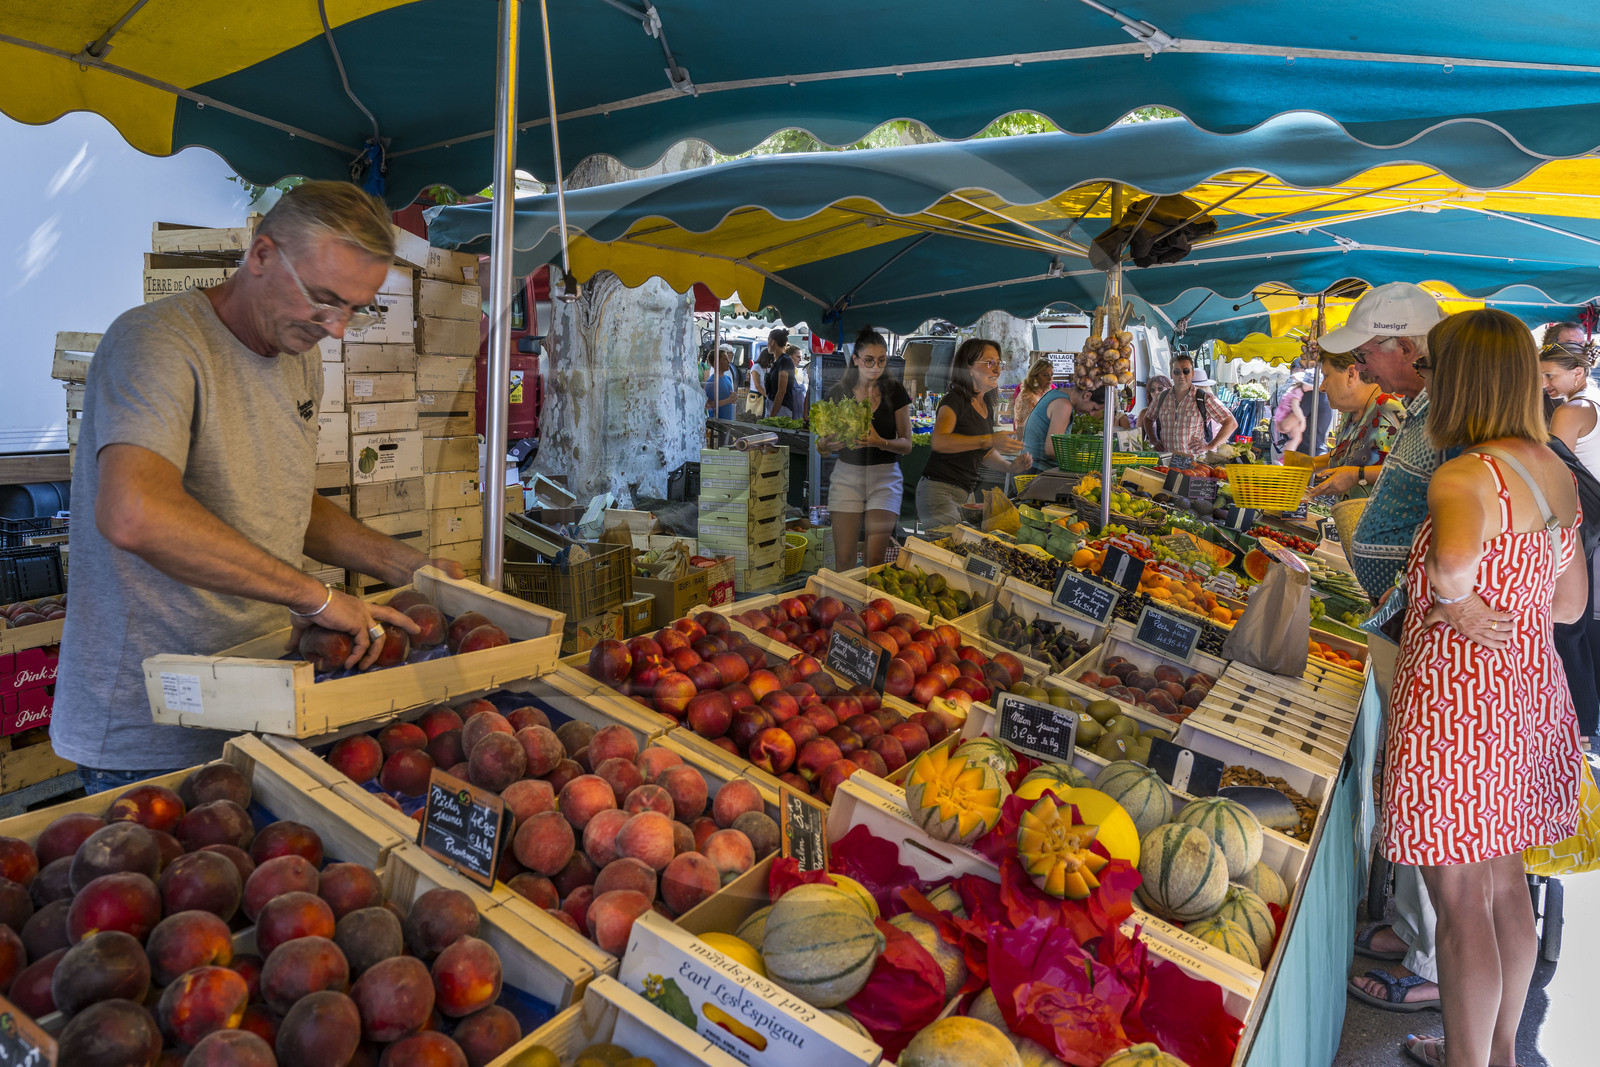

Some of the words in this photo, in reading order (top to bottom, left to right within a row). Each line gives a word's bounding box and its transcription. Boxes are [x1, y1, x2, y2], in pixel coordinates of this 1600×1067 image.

[145, 276, 172, 292] TERRE
[174, 281, 183, 292] DE
[13, 665, 48, 688] Pink
[15, 705, 48, 728] Pink
[1010, 711, 1032, 727] Melon
[445, 835, 480, 867] Provence
[689, 942, 751, 984] Espigau
[752, 980, 781, 1000] Les
[678, 961, 712, 991] Earl
[710, 983, 737, 1007] Les
[740, 999, 805, 1050] Espigau
[777, 998, 817, 1023] Earl
